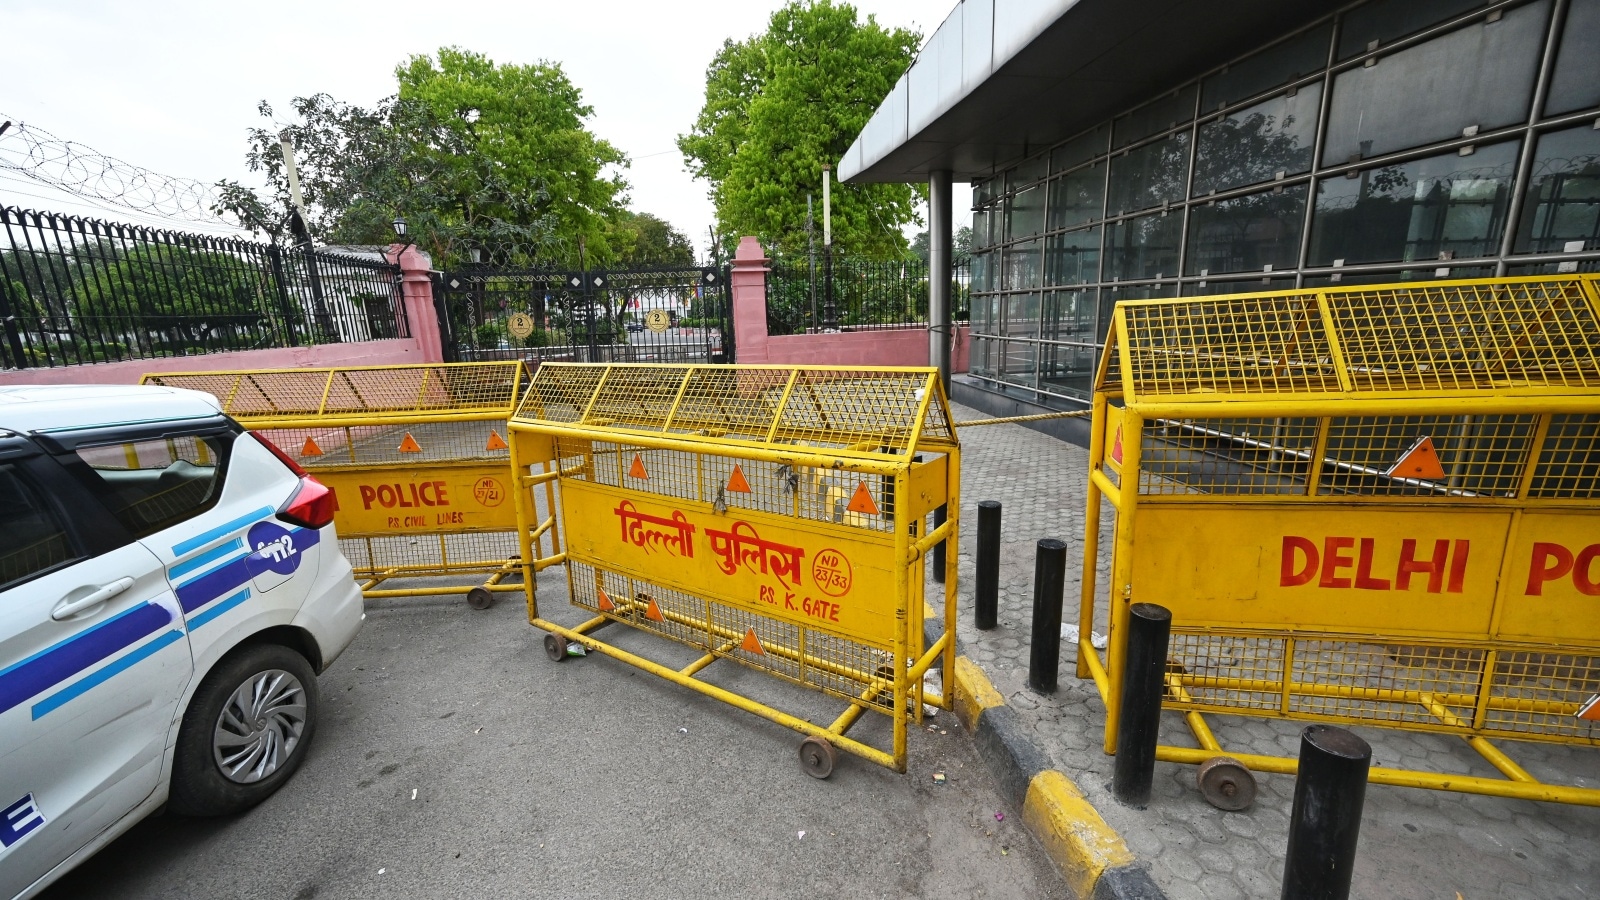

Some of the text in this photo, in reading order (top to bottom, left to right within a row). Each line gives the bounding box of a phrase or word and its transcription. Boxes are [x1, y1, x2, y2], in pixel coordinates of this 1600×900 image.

[517, 317, 524, 327] 2
[655, 313, 661, 322] 2
[482, 480, 494, 488] ND
[359, 481, 450, 510] POLICE
[404, 515, 427, 528] CIVIL
[437, 511, 464, 526] LINES
[614, 500, 805, 591] दिल्ली पुलिस
[822, 555, 839, 567] ND
[1280, 536, 1470, 594] DELHI
[803, 597, 840, 622] GATE
